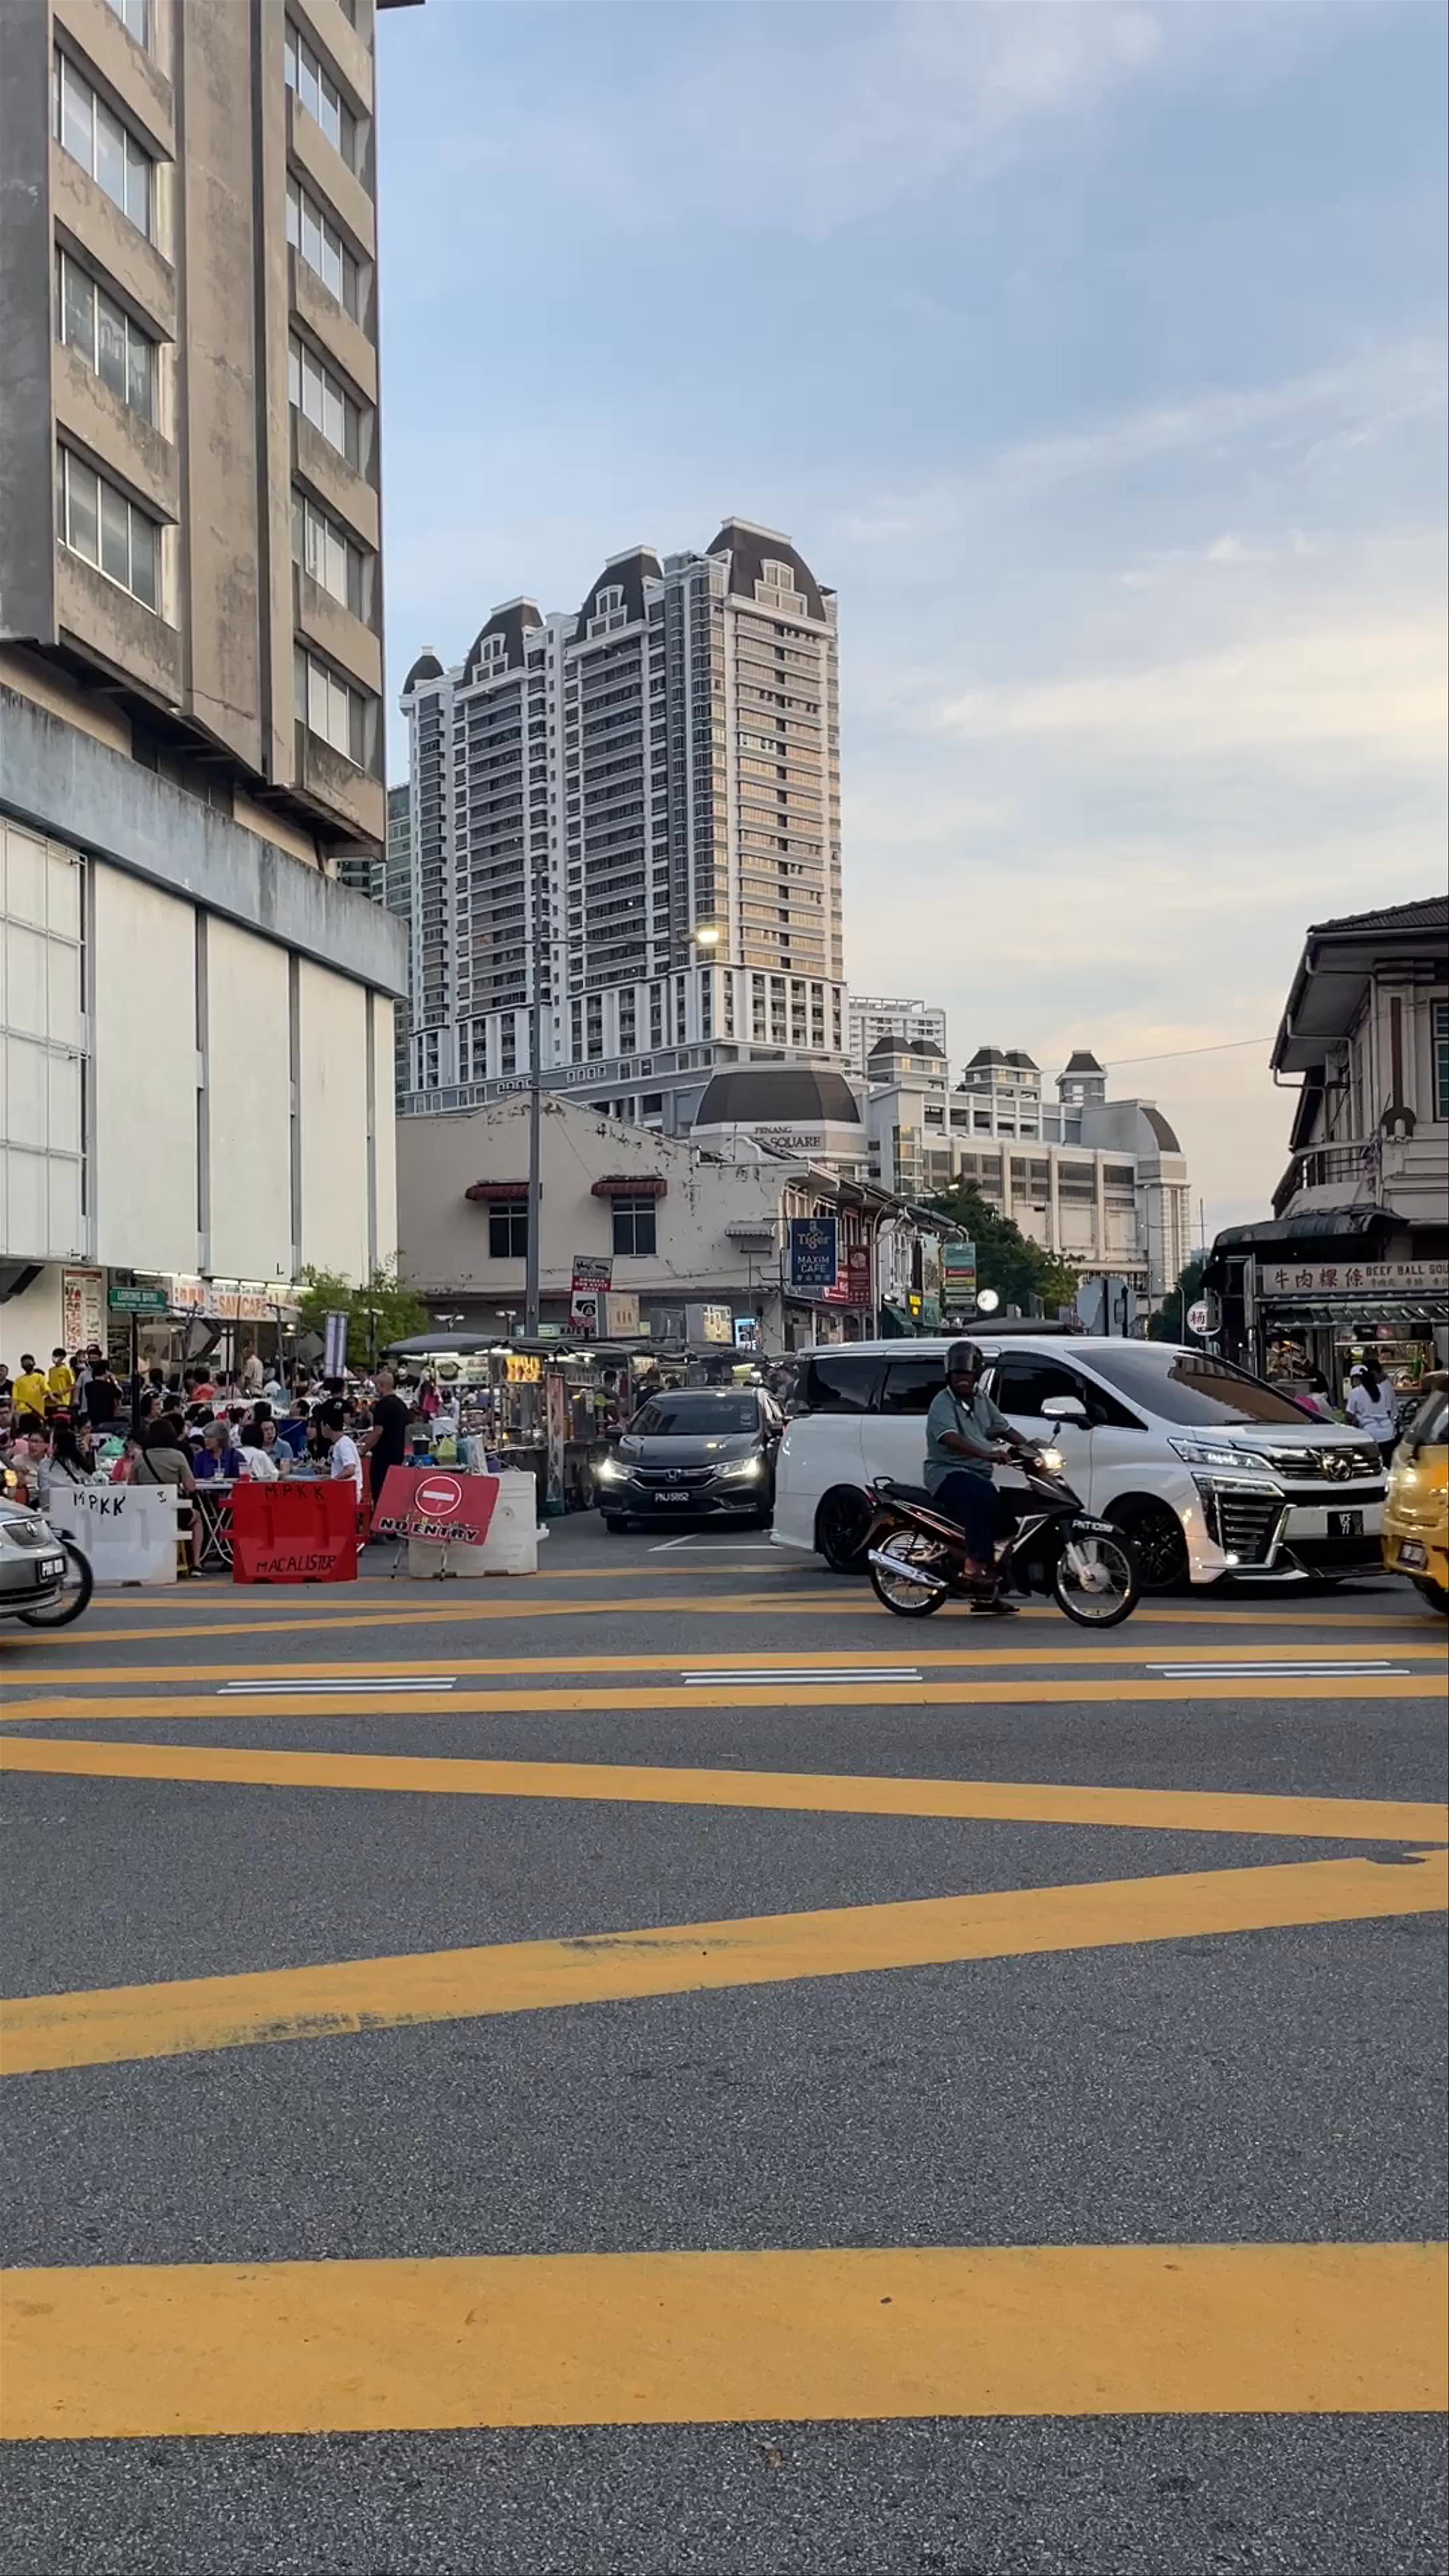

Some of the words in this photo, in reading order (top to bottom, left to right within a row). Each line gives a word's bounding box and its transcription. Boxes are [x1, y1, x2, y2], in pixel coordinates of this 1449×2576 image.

[771, 1137, 821, 1148] SQUARE
[797, 1232, 832, 1249] Tiger
[797, 1255, 829, 1264] MAXIM
[801, 1264, 827, 1273] CAFE
[1366, 1266, 1392, 1277] BEEF
[1397, 1265, 1425, 1276] BALL
[265, 1484, 325, 1502] MPKK
[73, 1491, 126, 1516] MPKK
[379, 1518, 408, 1532] NO
[412, 1523, 479, 1541] ENTRY
